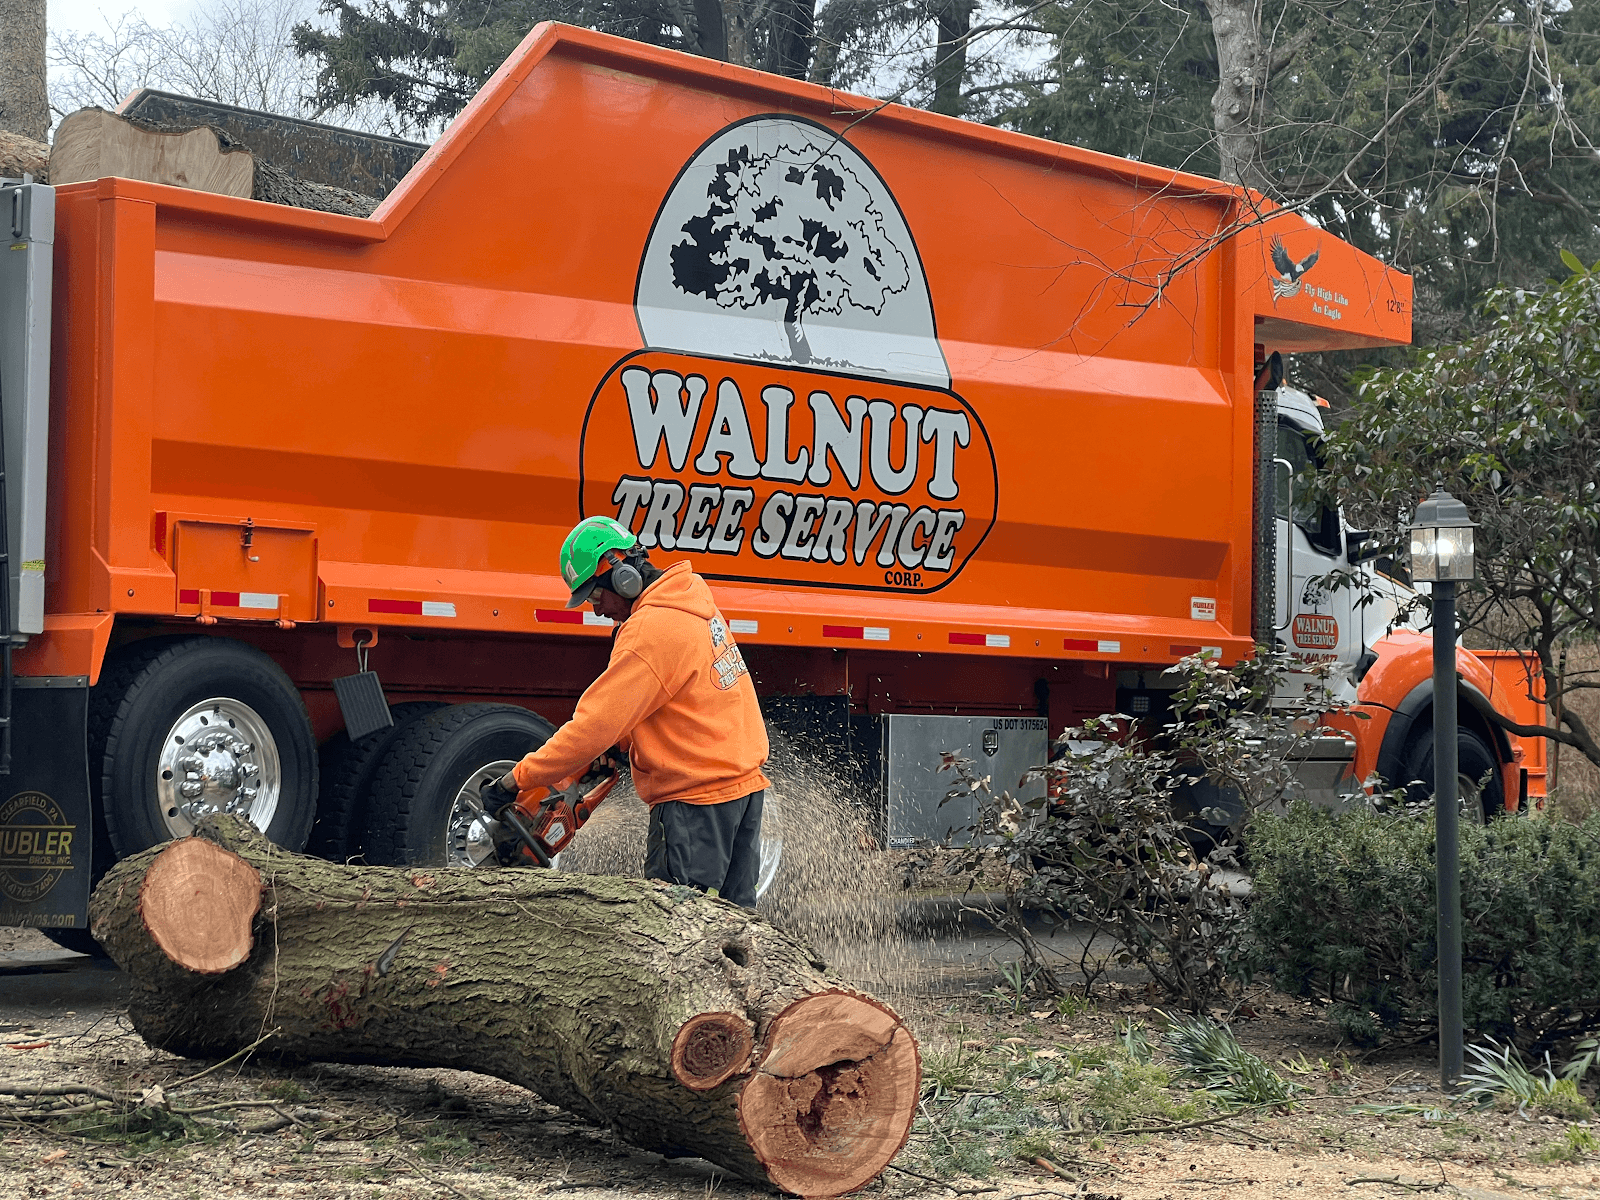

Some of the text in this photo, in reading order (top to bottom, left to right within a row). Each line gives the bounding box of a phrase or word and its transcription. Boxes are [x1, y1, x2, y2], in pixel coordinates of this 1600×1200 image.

[1305, 283, 1348, 306] Fly High Like
[1312, 302, 1341, 320] An Eagle
[621, 366, 970, 499] WALNUT
[612, 475, 965, 571] TREE SERVICE
[884, 571, 924, 587] CORP.
[1296, 617, 1335, 634] WALNUT
[1296, 634, 1335, 646] TREE SERVICE
[993, 719, 1047, 730] US DOT 3175624
[48, 807, 58, 821] PA
